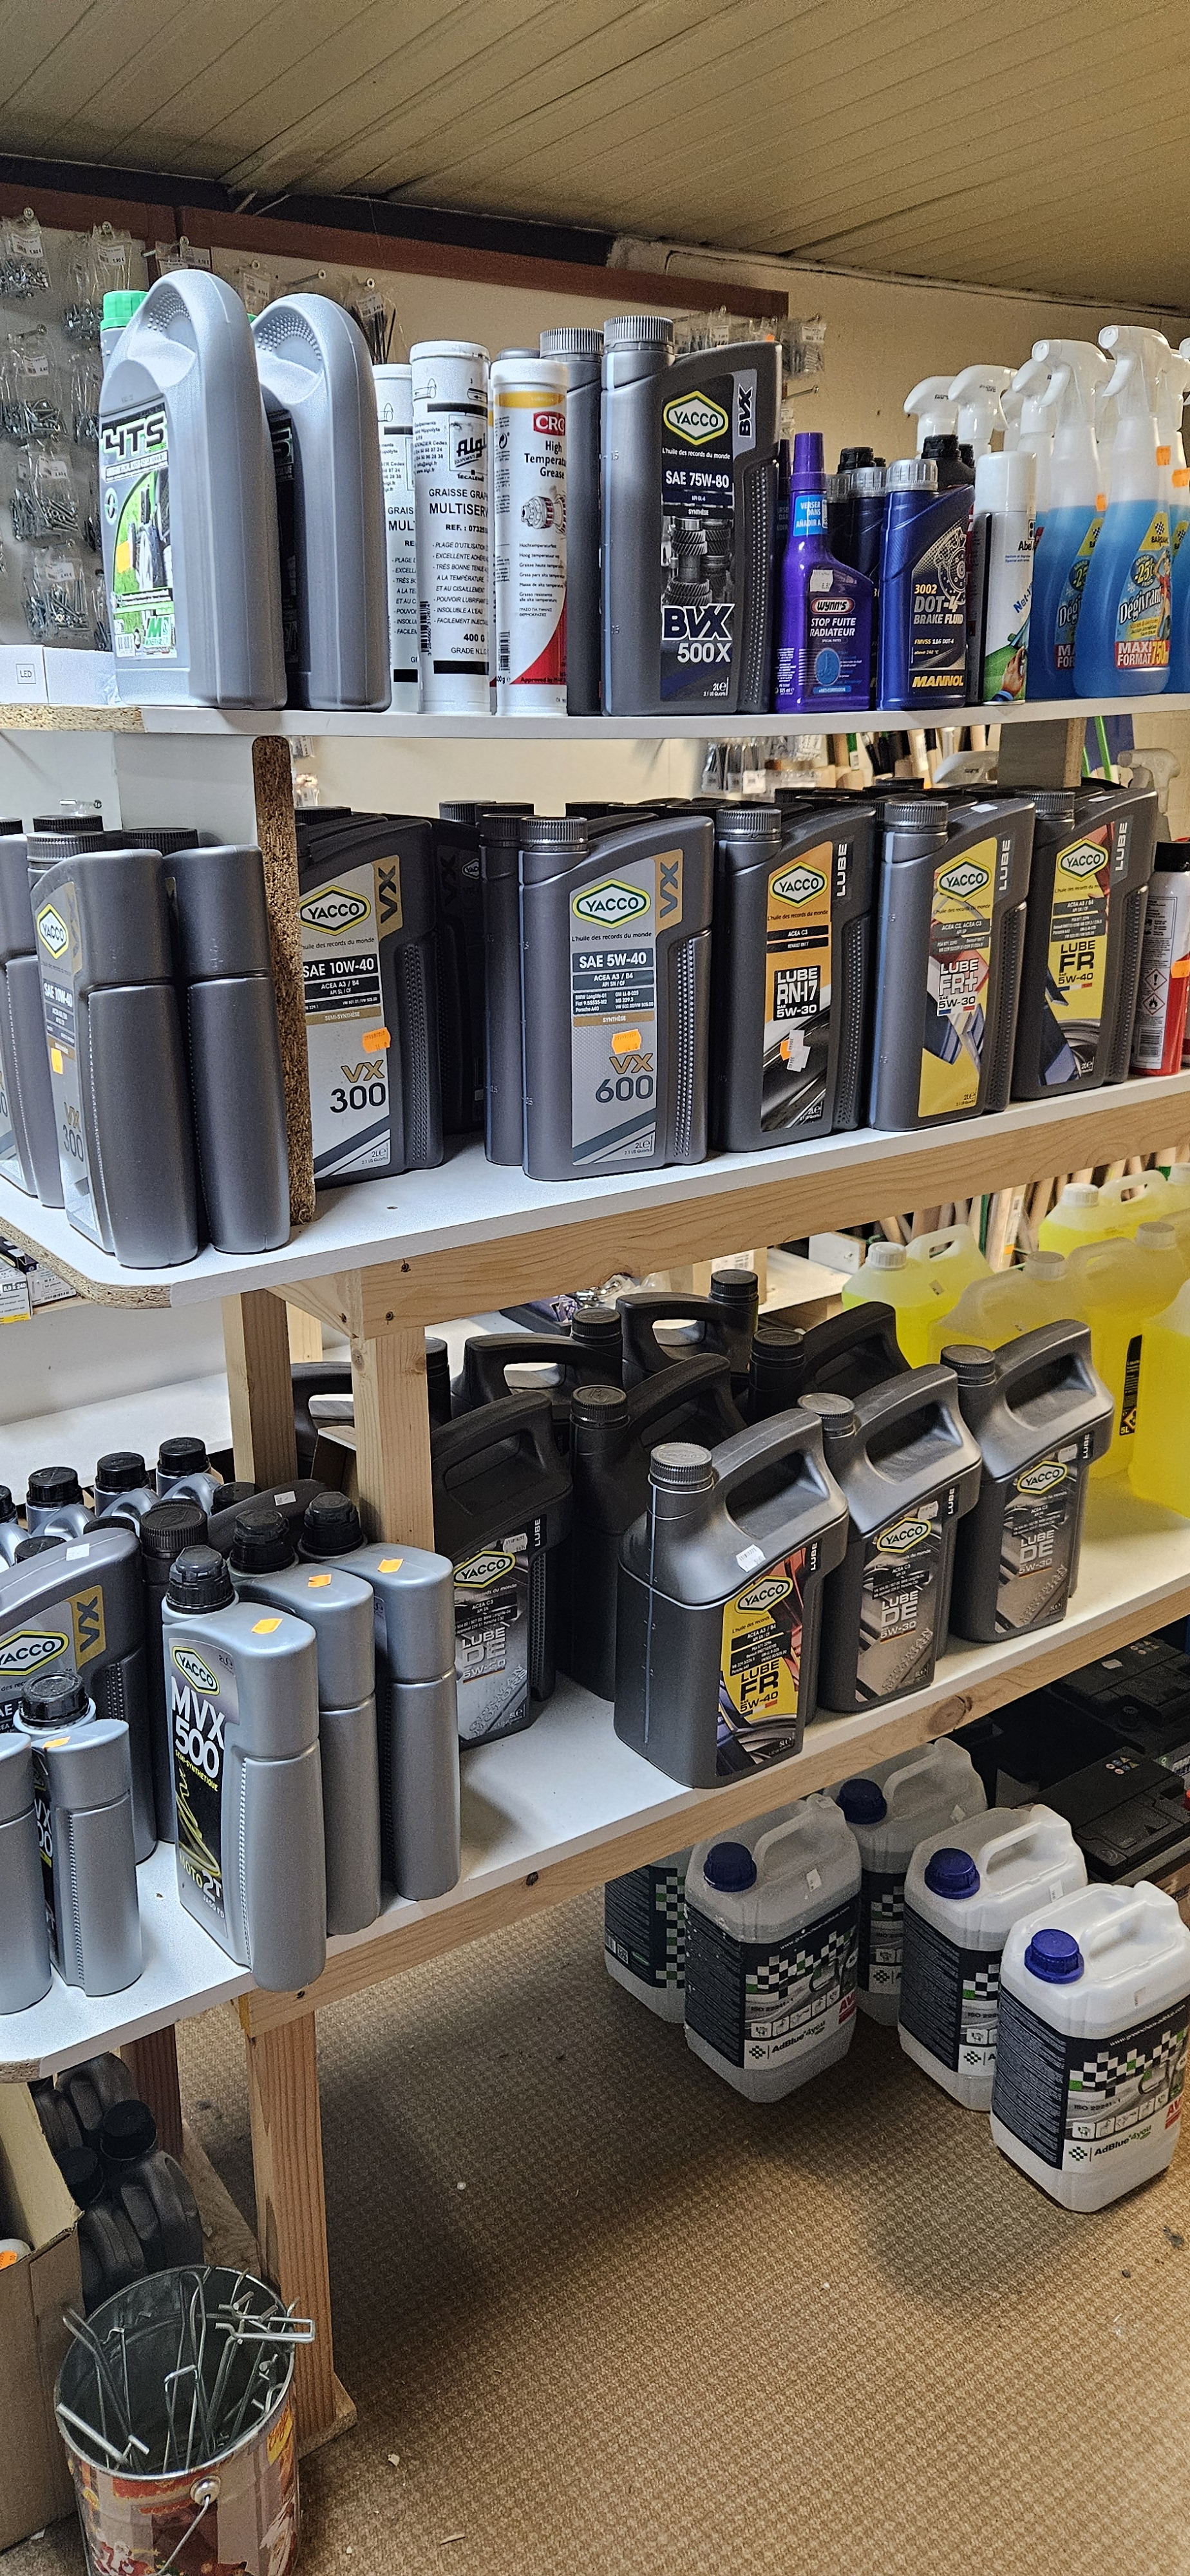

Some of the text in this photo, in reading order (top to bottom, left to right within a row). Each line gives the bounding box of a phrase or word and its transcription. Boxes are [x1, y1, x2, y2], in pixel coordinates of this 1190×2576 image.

[674, 410, 719, 428] YACCO
[738, 384, 753, 438] BVX
[545, 440, 562, 455] High
[688, 450, 705, 459] records
[524, 453, 566, 467] Temperatu
[540, 467, 565, 479] Grease
[666, 470, 729, 488] SAE 75W-80
[429, 488, 468, 498] GRAISSE
[800, 500, 821, 509] VERSER
[914, 584, 938, 594] 3002
[914, 595, 959, 613] DOT-4
[661, 603, 735, 641] BVX
[811, 618, 856, 627] STOP FUITE
[913, 613, 963, 625] BRAKE FLUID
[463, 633, 478, 642] 400
[809, 628, 856, 637] RADIATEUR
[1119, 641, 1151, 654] MAXI
[1117, 652, 1151, 666] FORMAT
[19, 669, 32, 679] LED
[912, 675, 964, 688] MANNOL
[1115, 822, 1128, 871] LUBE
[836, 842, 847, 896] LUBE
[999, 839, 1010, 891] LUBE
[1066, 854, 1101, 868] YACCO
[660, 860, 678, 918] VX
[779, 877, 819, 893] YACCO
[946, 873, 984, 887] YACCO
[378, 865, 397, 923] VX
[307, 904, 359, 920] YACCO
[585, 897, 639, 912] YACCO
[42, 923, 64, 942] YACCO
[1061, 940, 1095, 954] LUBE
[303, 958, 374, 978] SAE 10W-40
[579, 952, 647, 969] SAE 5W-40
[940, 958, 979, 975] LUBE
[1059, 951, 1095, 973] FR
[777, 967, 818, 983] LUBE
[939, 971, 978, 997] FR+
[1058, 972, 1093, 985] 5W-40
[44, 982, 54, 998] SAE
[777, 980, 818, 1005] RN-17
[777, 1004, 817, 1018] 5W-30
[939, 996, 976, 1009] 5W-30
[341, 1059, 385, 1083] VX
[609, 1053, 654, 1074] VX
[330, 1082, 386, 1113] 300
[595, 1075, 654, 1103] 600
[64, 1102, 81, 1133] VX
[63, 1124, 84, 1162] 300
[1120, 1426, 1129, 1434] 5L
[1026, 1469, 1060, 1486] YACCO
[885, 1526, 923, 1545] YACCO
[1021, 1530, 1055, 1547] LUBE
[1020, 1539, 1053, 1564] DE
[461, 1559, 505, 1579] YACCO
[1019, 1558, 1052, 1575] 5W-30
[744, 1584, 784, 1607] YACCO
[882, 1590, 919, 1610] LUBE
[472, 1602, 486, 1610] ACEA
[881, 1600, 918, 1628] DE
[77, 1596, 100, 1653] VX
[880, 1620, 916, 1639] 5W-30
[462, 1627, 505, 1649] LUBE
[747, 1631, 759, 1639] ACEA
[462, 1638, 505, 1667] DE
[178, 1653, 214, 1687] YACCO
[741, 1660, 779, 1682] LUBE
[741, 1670, 779, 1701] FR
[740, 1691, 778, 1712] 5W-40
[171, 1676, 225, 1750] MVX
[175, 1715, 219, 1779] 500
[179, 1855, 223, 1903] MOTO 2T
[772, 2033, 804, 2053] AdBlue
[1094, 2138, 1129, 2156] AdBlue
